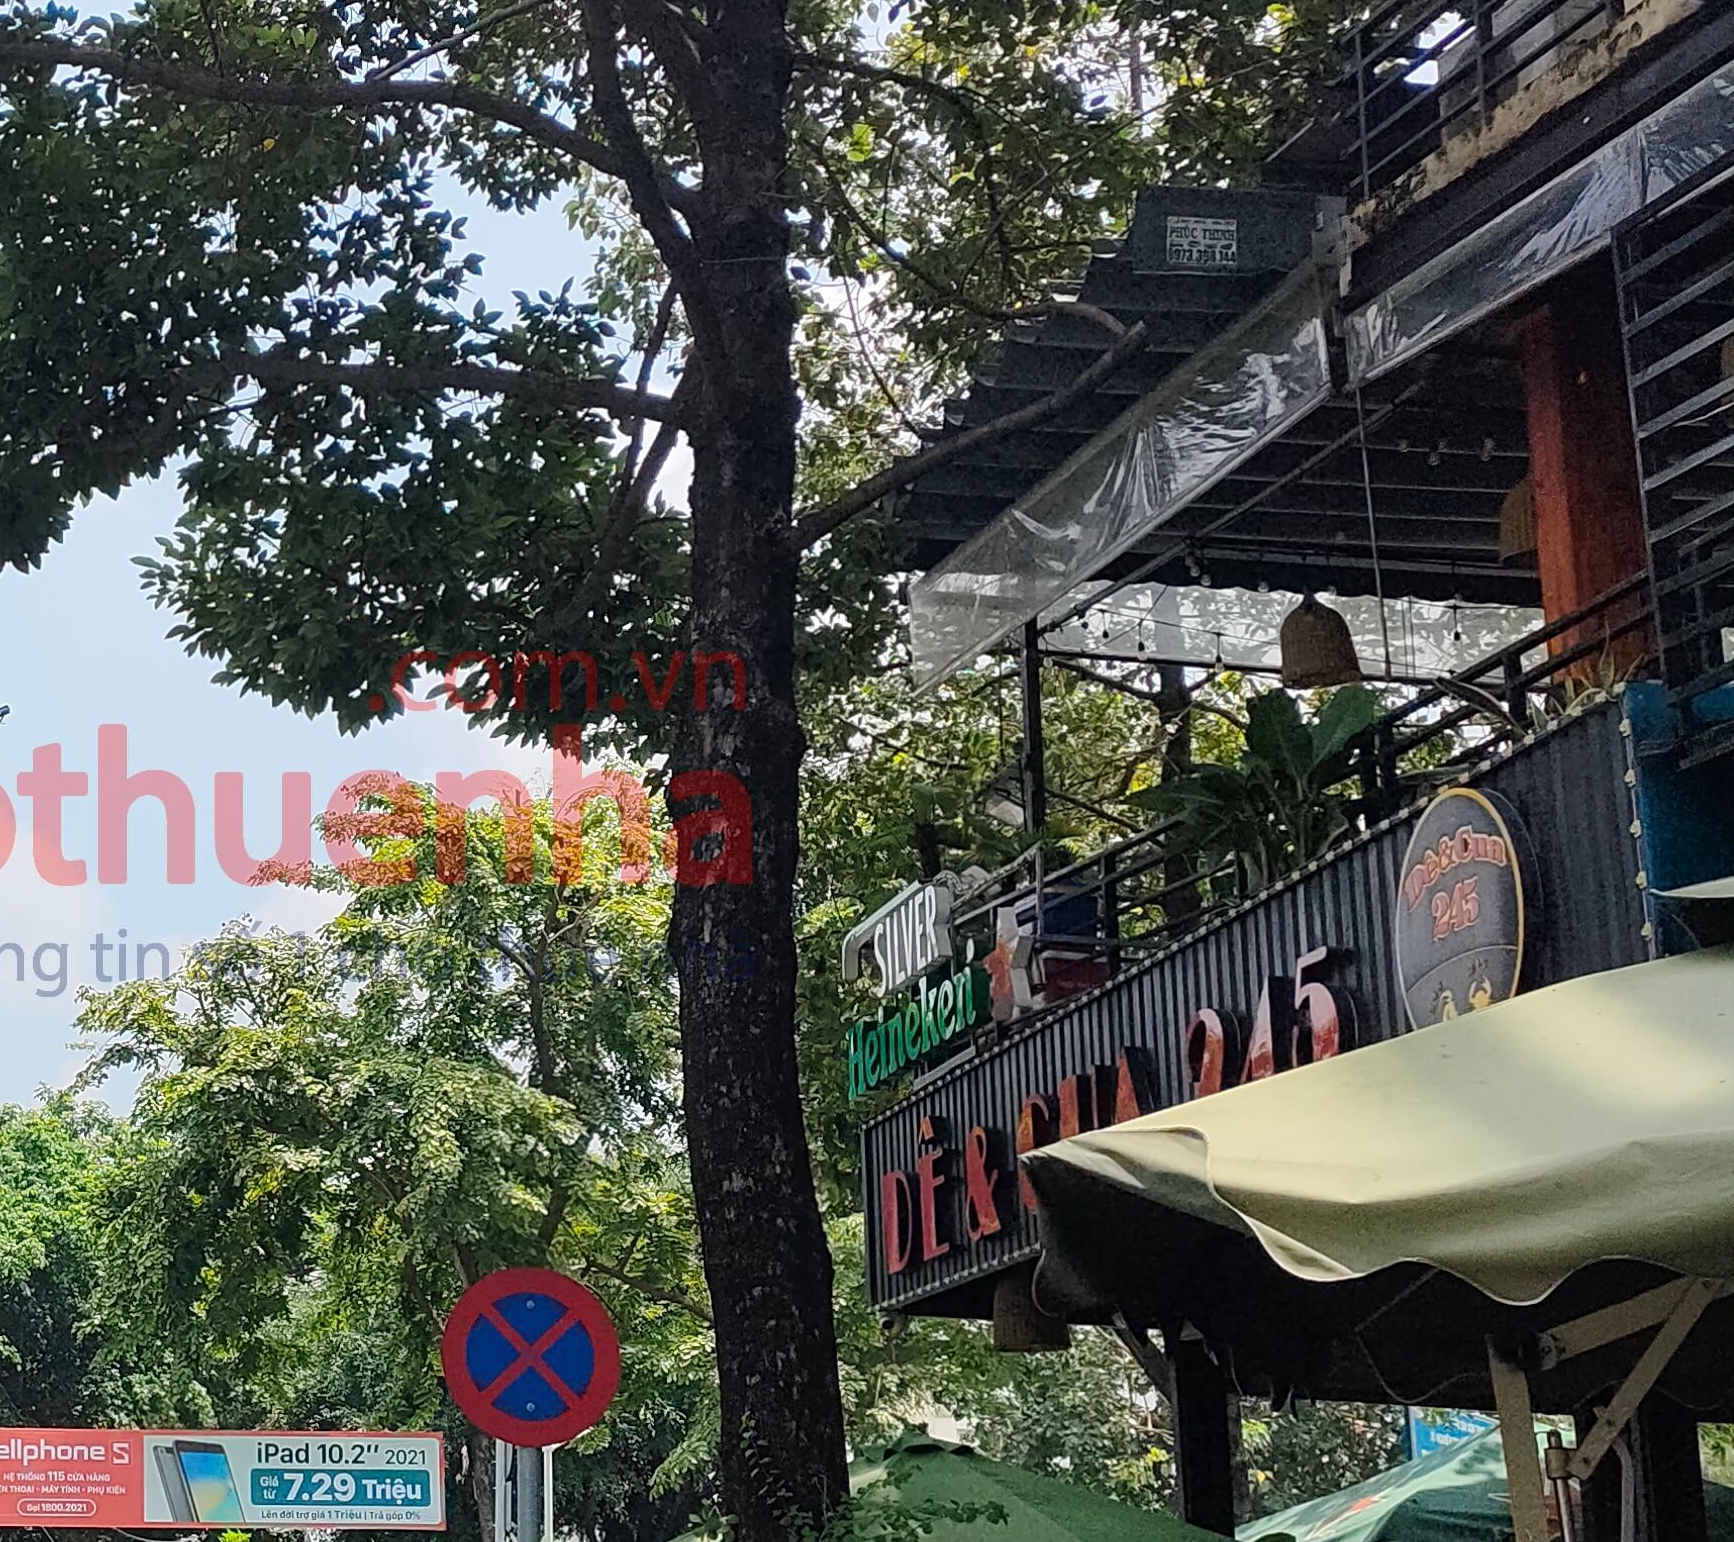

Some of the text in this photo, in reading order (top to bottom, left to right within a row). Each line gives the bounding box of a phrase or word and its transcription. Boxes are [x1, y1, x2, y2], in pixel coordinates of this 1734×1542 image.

[1430, 876, 1480, 942] 245
[874, 885, 939, 998] SILVER
[845, 937, 977, 1102] Heineken
[882, 1115, 951, 1275] DÊ
[257, 1442, 310, 1464] iPad
[384, 1449, 427, 1465] 2021
[41, 1483, 59, 1494] MÁY
[47, 1470, 65, 1481] 115
[260, 1475, 279, 1487] Giá
[283, 1472, 422, 1505] 7.29 Triệu
[335, 1510, 362, 1521] Triệu
